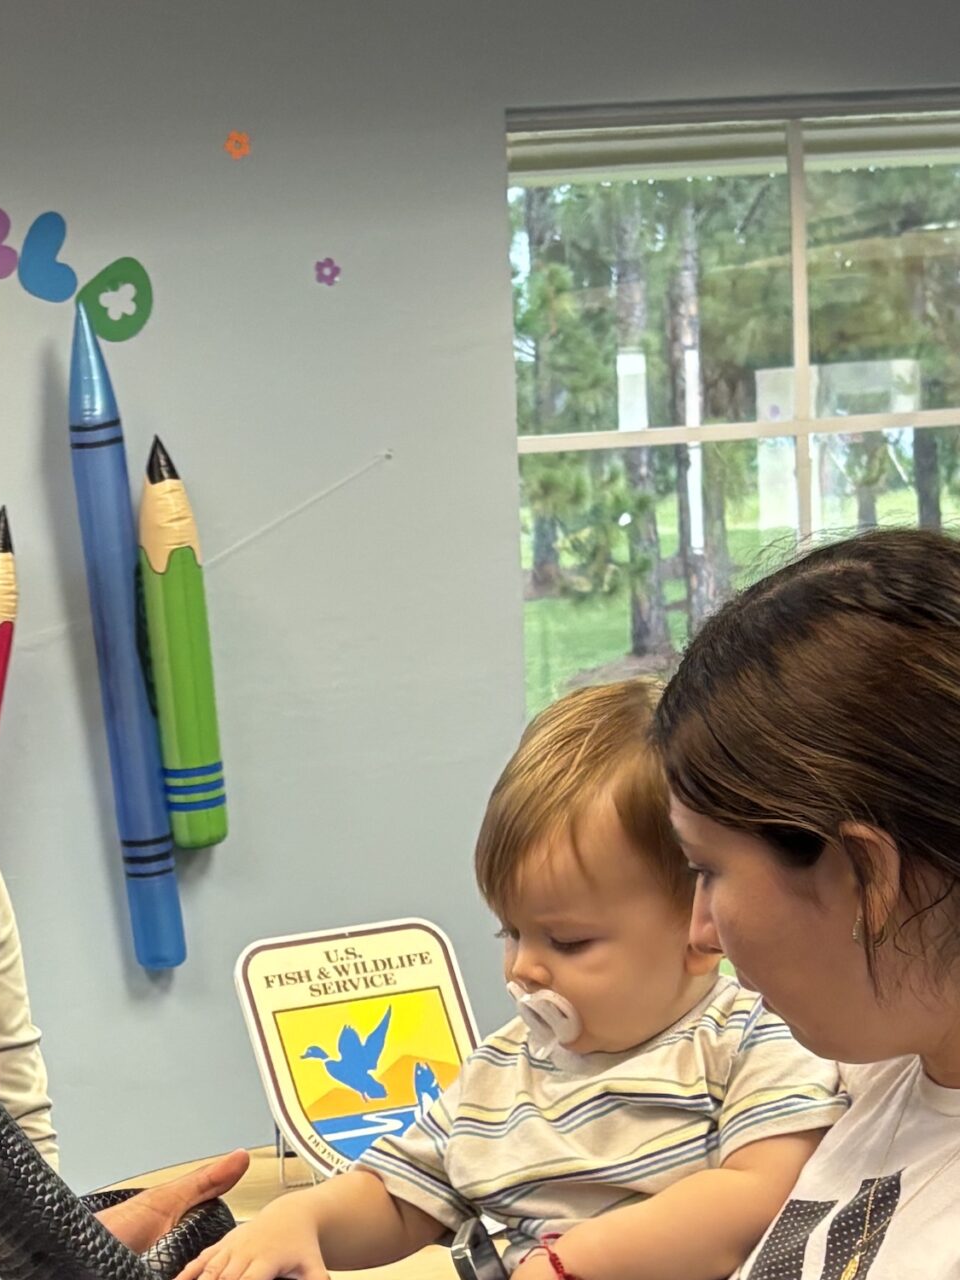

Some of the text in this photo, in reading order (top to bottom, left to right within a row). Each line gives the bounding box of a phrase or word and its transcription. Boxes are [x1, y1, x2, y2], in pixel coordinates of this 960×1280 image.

[323, 946, 363, 964] U.S.
[263, 951, 433, 989] FISH & WILDLIFE
[308, 972, 398, 998] SERVICE
